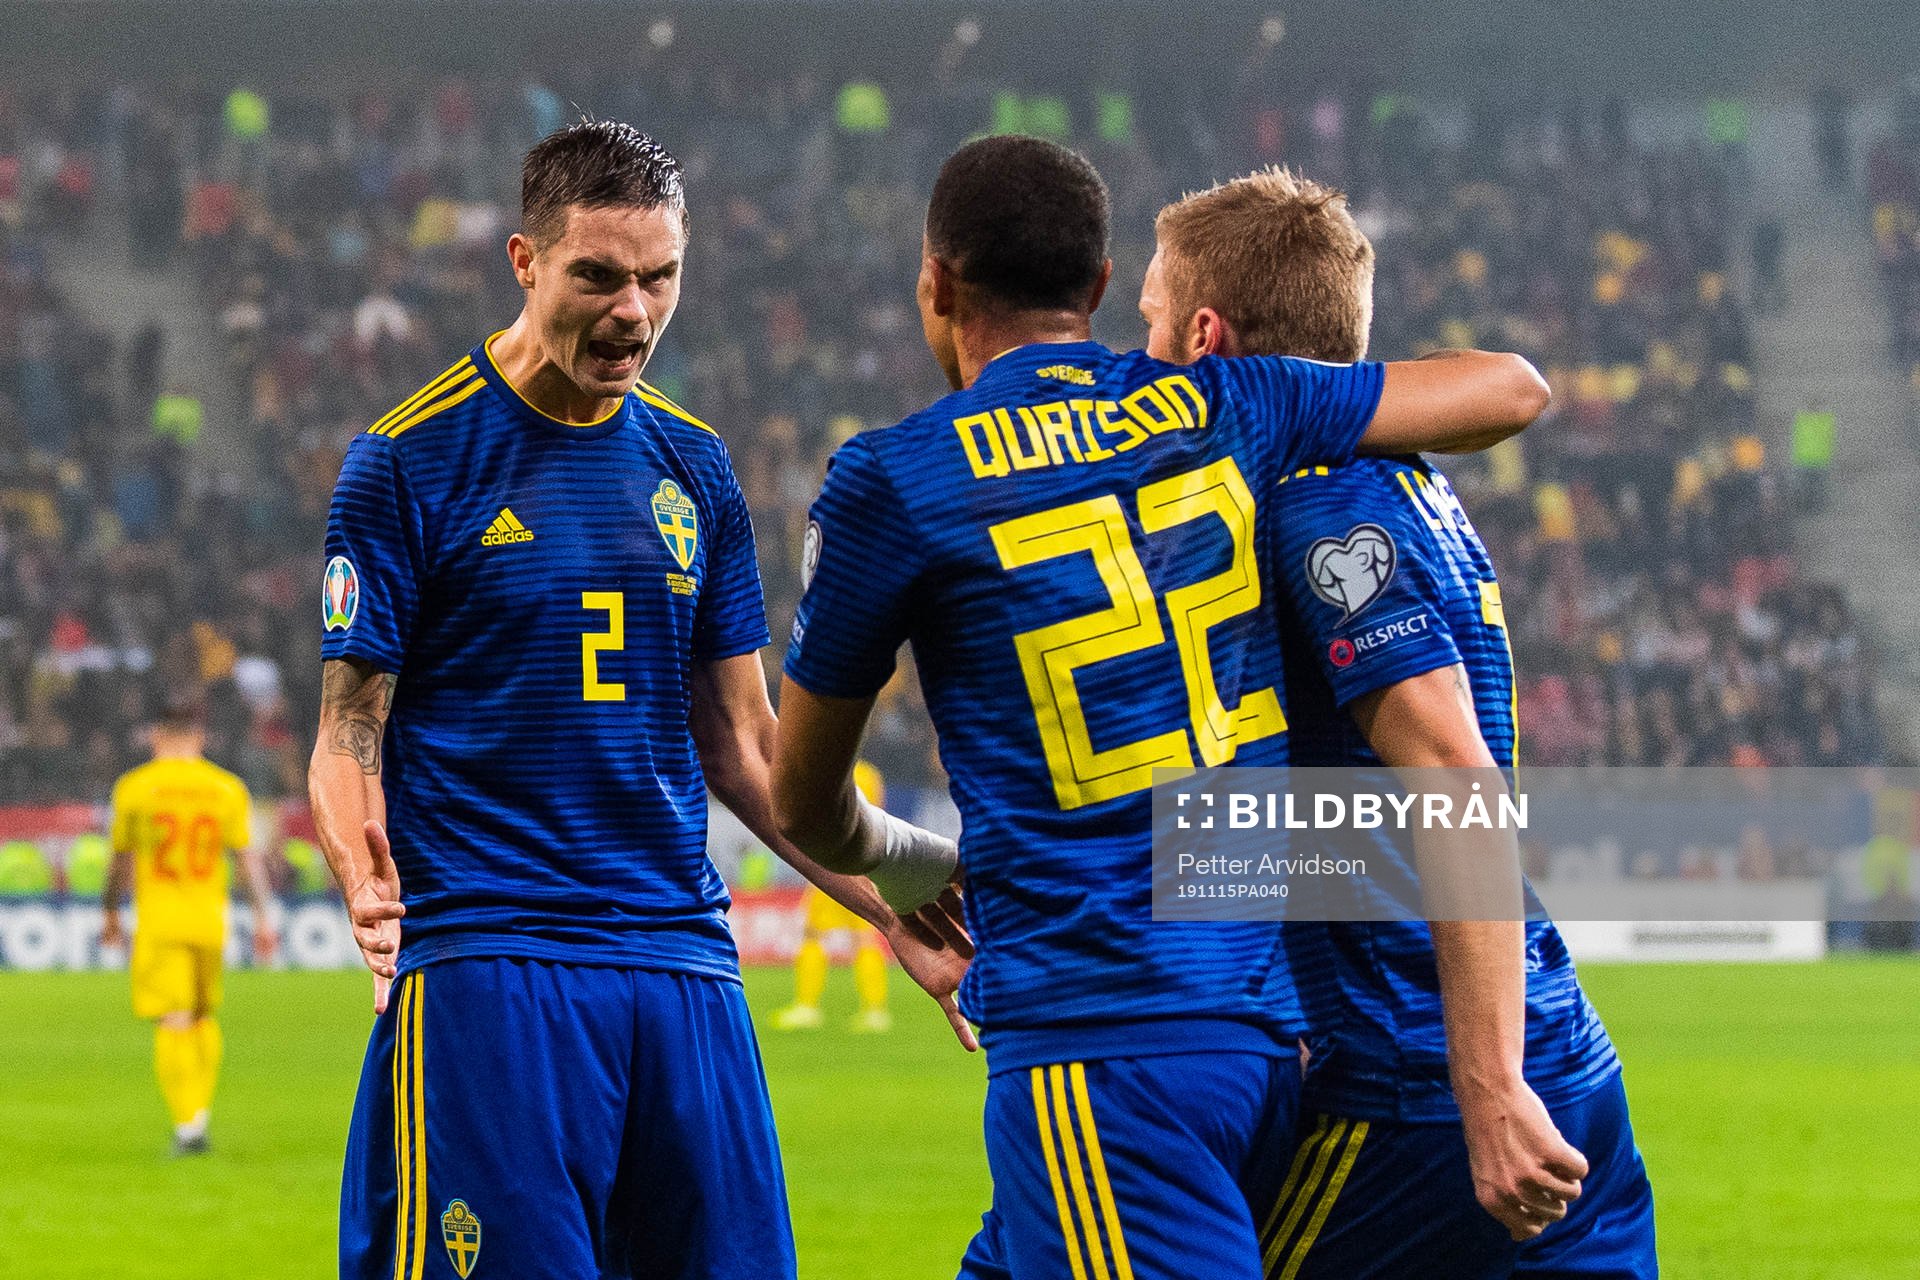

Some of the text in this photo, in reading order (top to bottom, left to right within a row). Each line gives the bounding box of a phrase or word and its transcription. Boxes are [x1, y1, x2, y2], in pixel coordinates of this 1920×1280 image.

[953, 375, 1208, 479] QUAISON
[481, 529, 535, 546] adidas
[581, 591, 626, 701] 2
[988, 456, 1289, 812] 22
[1353, 614, 1428, 653] RESPECT
[151, 812, 222, 881] 20
